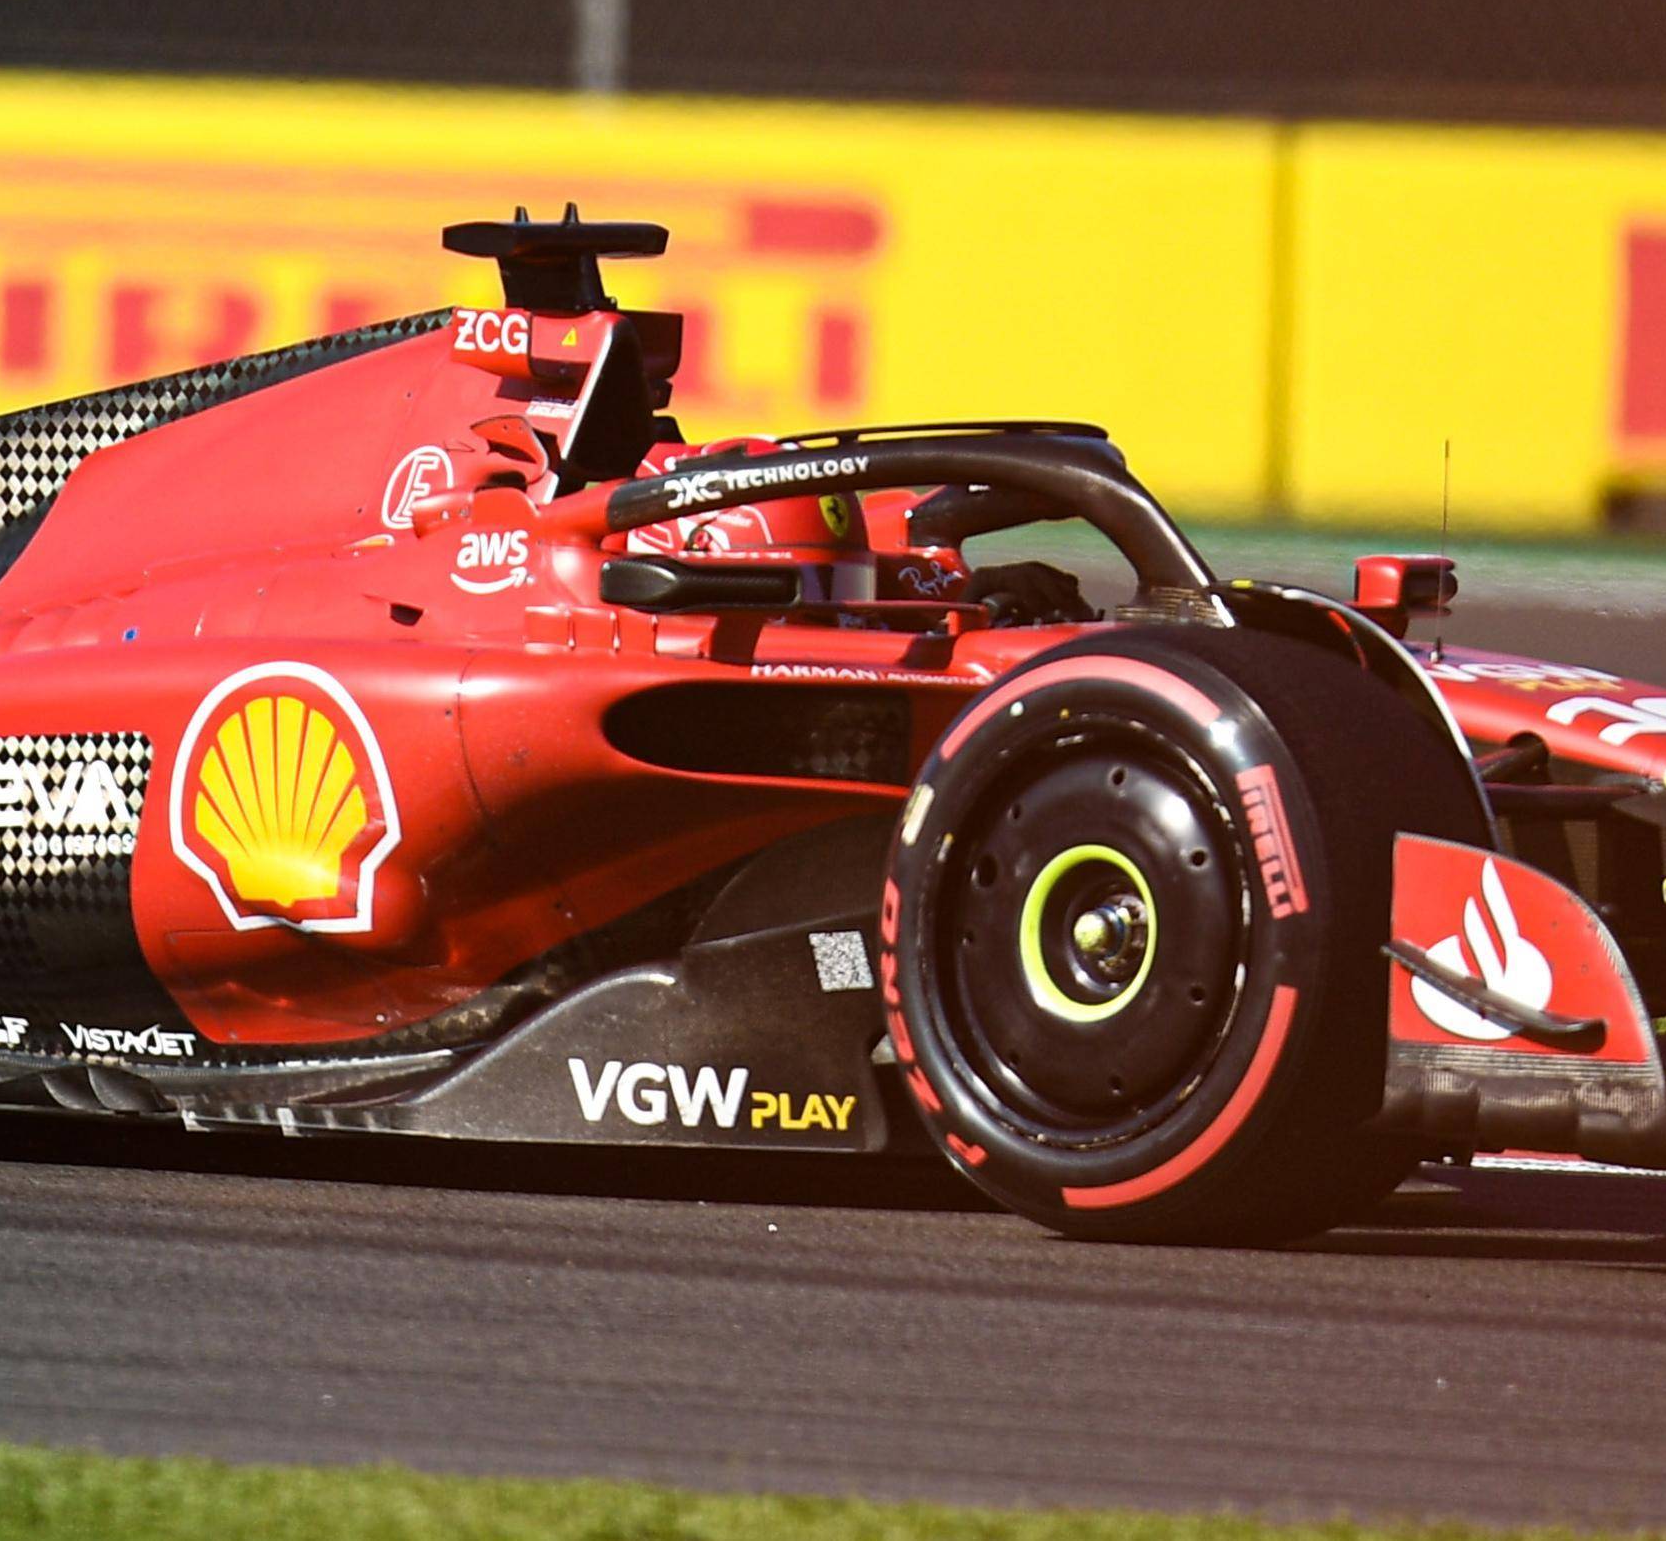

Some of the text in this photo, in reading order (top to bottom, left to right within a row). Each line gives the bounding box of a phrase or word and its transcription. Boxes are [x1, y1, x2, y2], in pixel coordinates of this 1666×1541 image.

[454, 309, 529, 354] ZCG
[724, 456, 870, 490] TECHNOLOGY
[456, 529, 530, 569] aws
[1236, 763, 1309, 921] PIRELLI
[568, 1059, 856, 1132] VGW PLAY
